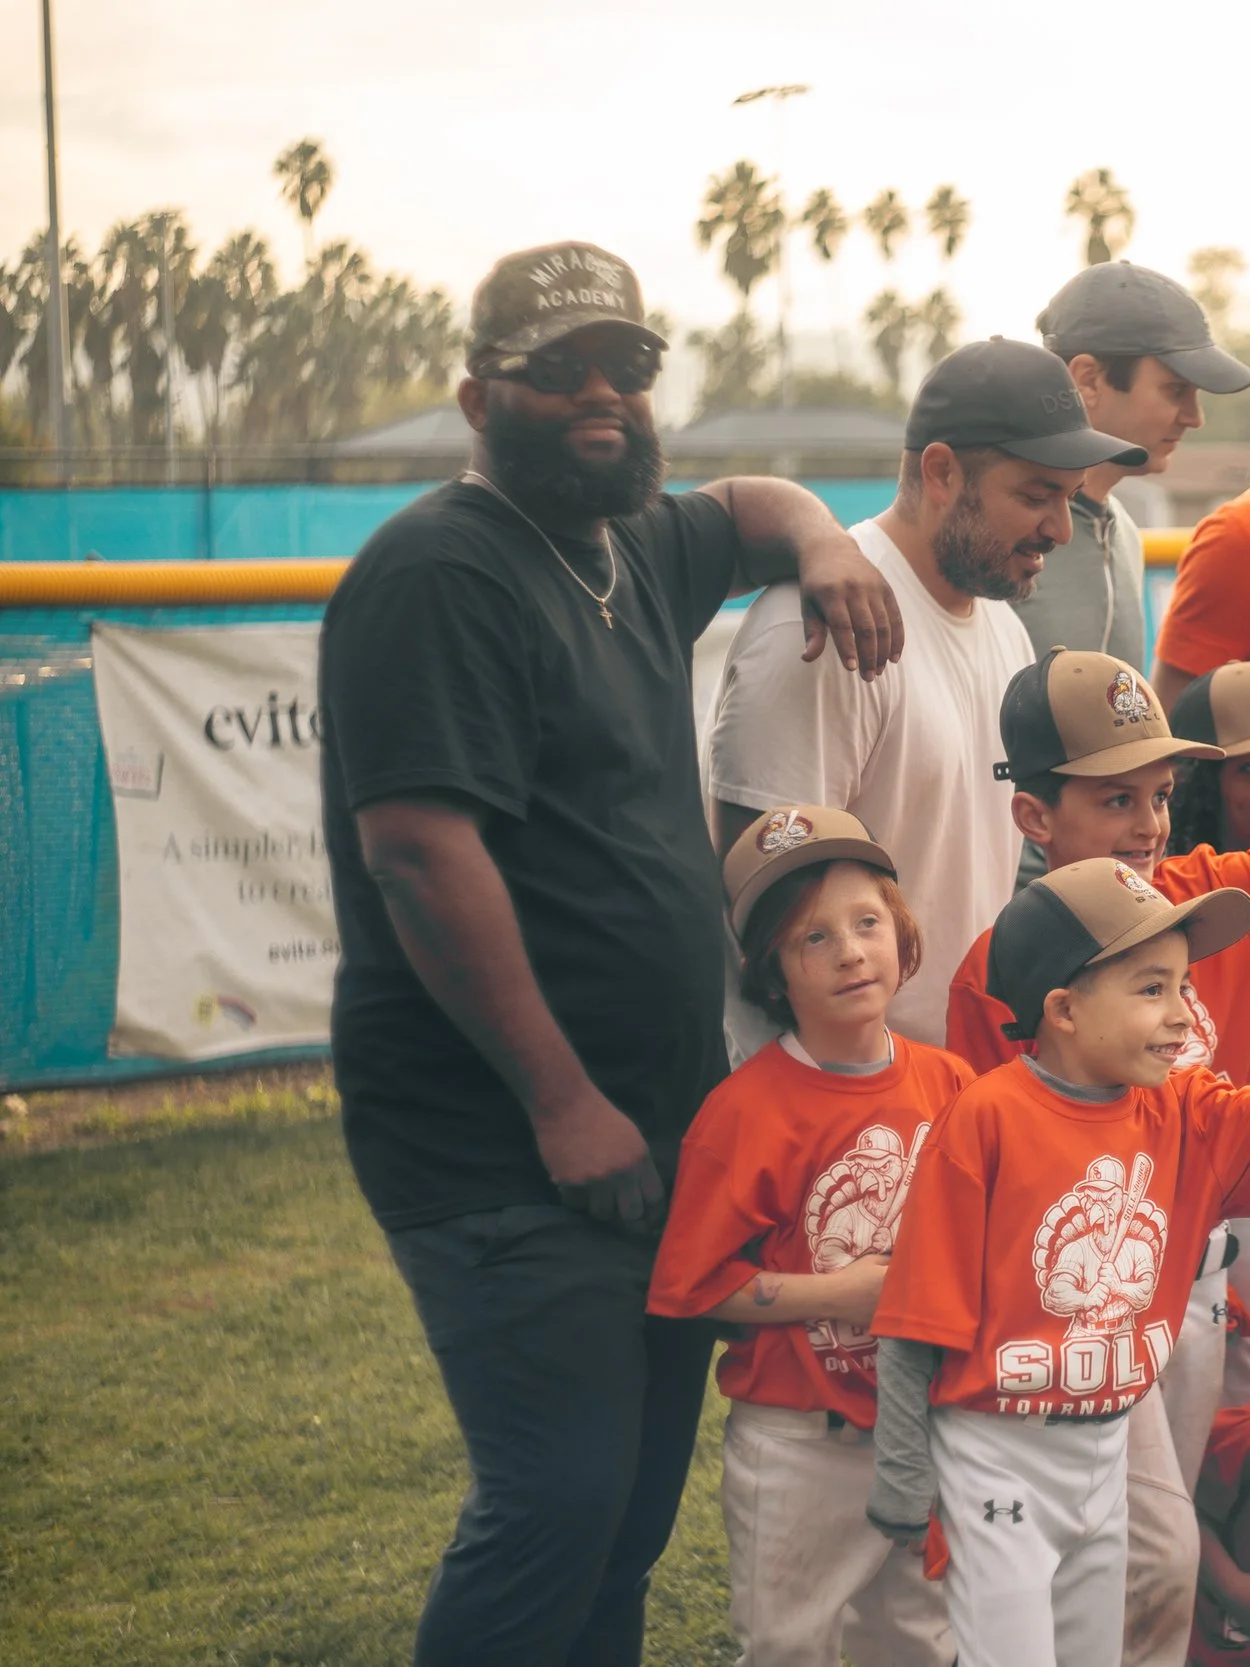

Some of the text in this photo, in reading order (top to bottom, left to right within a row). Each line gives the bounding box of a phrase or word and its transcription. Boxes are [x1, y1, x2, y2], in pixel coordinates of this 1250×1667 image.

[538, 289, 626, 312] ACADEMY
[1113, 712, 1160, 727] SOLL
[1123, 1196, 1137, 1221] SOLL
[997, 1393, 1148, 1416] TOURNAM
